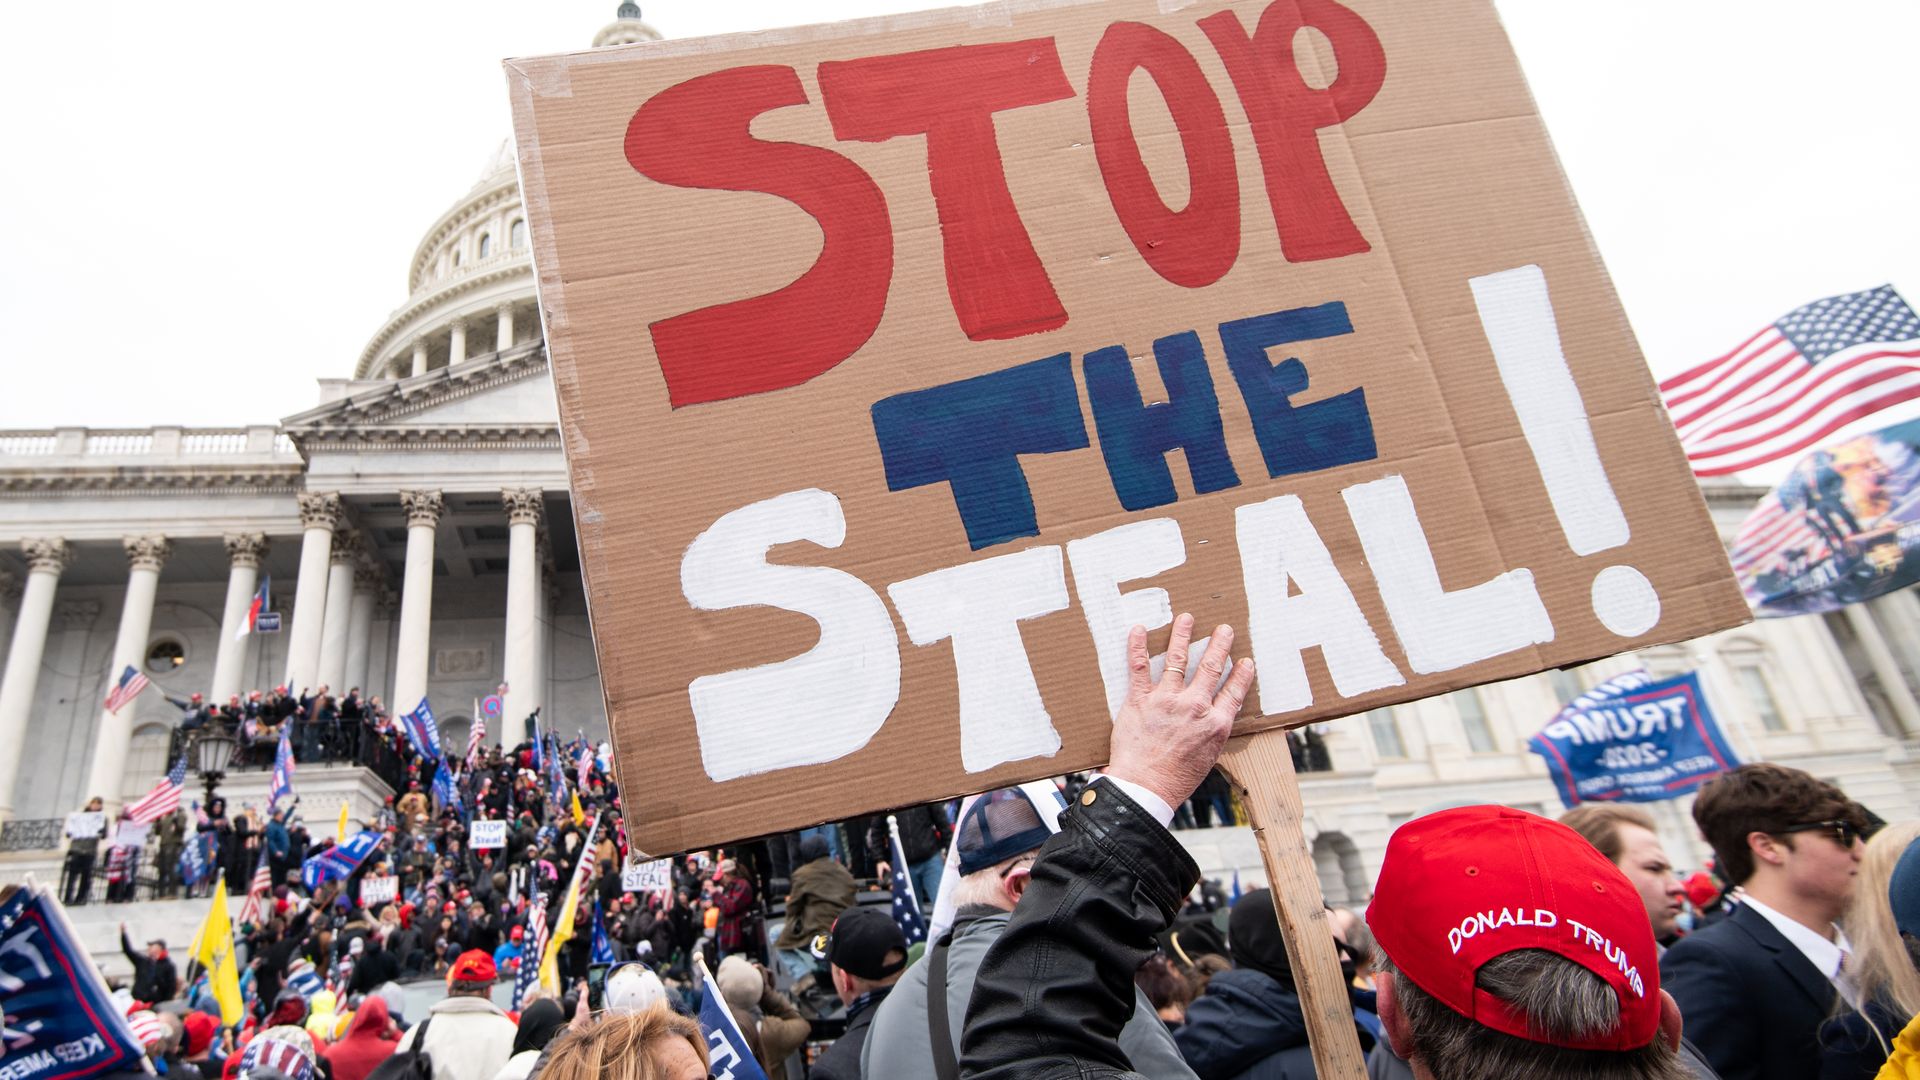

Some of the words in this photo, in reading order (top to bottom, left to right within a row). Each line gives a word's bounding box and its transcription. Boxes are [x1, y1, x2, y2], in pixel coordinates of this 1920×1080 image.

[624, 0, 1387, 409] STOP
[870, 300, 1378, 551] THE
[625, 871, 665, 887] STEAL
[1447, 906, 1558, 955] DONALD
[1565, 918, 1645, 999] TRUMP
